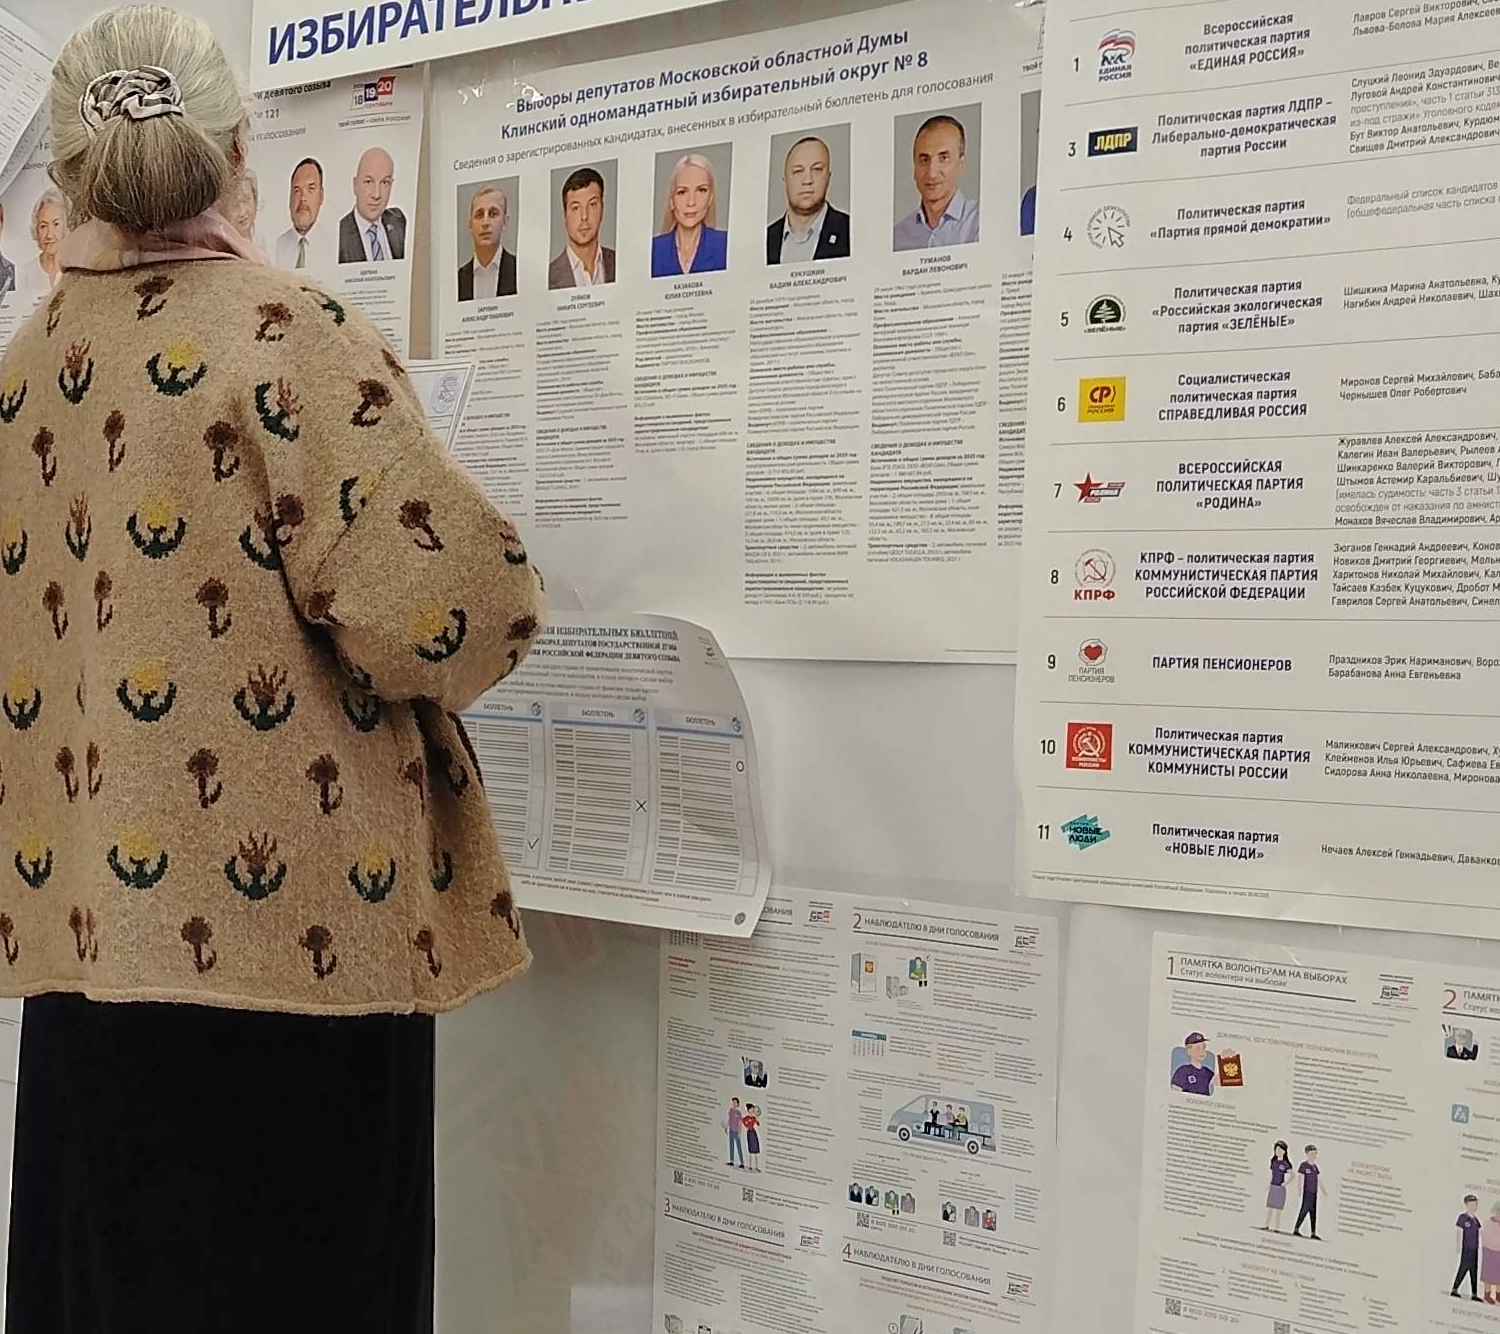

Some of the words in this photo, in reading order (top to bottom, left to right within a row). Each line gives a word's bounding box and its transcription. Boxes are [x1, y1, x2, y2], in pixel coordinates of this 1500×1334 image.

[1203, 14, 1293, 36] Всероссийская
[1185, 35, 1267, 55] политическая
[1269, 29, 1310, 45] партия
[1073, 57, 1080, 72] 1
[1189, 53, 1246, 72] «ЕДИНАЯ
[1249, 46, 1305, 64] РОССИЯ»
[516, 91, 573, 114] Выборы
[575, 77, 655, 105] депутатов
[659, 55, 760, 87] Московской
[764, 37, 853, 69] областной
[856, 30, 908, 56] Думы
[1098, 64, 1132, 75] ЕДИНАЯ
[1098, 72, 1132, 82] РОССИЯ
[501, 113, 566, 140] Клинский
[569, 91, 698, 129] одномандатный
[701, 67, 835, 105] избирательный
[839, 61, 890, 81] округ
[894, 54, 913, 72] №
[917, 51, 928, 68] 8
[265, 109, 279, 119] 121
[1157, 109, 1242, 127] Политическая
[1245, 104, 1285, 119] партия
[1287, 97, 1323, 113] ЛДПР
[453, 155, 496, 171] Сведения
[497, 154, 504, 164] о
[505, 137, 602, 163] зарегистрированных
[603, 127, 665, 145] кандидатах,
[667, 117, 727, 135] внесенных
[728, 116, 736, 126] в
[737, 98, 823, 124] избирательный
[824, 91, 889, 109] бюллетень
[890, 86, 914, 101] для
[916, 72, 993, 95] голосования
[1151, 115, 1337, 145] Либерально-демократическая
[1068, 142, 1077, 157] 3
[1094, 133, 1132, 152] ЛДПР
[1200, 144, 1241, 159] партия
[1244, 138, 1287, 153] России
[1177, 204, 1262, 221] Политическая
[1264, 200, 1305, 215] партия
[1063, 227, 1072, 242] 4
[1150, 226, 1200, 241] «Партия
[1203, 220, 1248, 238] прямой
[1249, 215, 1331, 234] демократии»
[919, 255, 951, 265] ТУМАНОВ
[1174, 284, 1258, 299] Политическая
[1261, 281, 1302, 295] партия
[1152, 302, 1231, 317] «Российская
[1233, 297, 1323, 313] экологическая
[1060, 311, 1069, 327] 5
[1178, 322, 1219, 335] партия
[1222, 313, 1295, 331] «ЗЕЛЁНЫЕ»
[1178, 371, 1291, 387] Социалистическая
[1169, 391, 1253, 404] политическая
[1256, 389, 1297, 402] партия
[1339, 390, 1388, 402] Чернышев
[1389, 388, 1412, 398] Олег
[1413, 386, 1467, 397] Робертович
[1057, 397, 1066, 412] 6
[1158, 406, 1255, 421] СПРАВЕДЛИВАЯ
[1258, 403, 1307, 418] РОССИЯ
[1178, 458, 1282, 475] ВСЕРОССИЙСКАЯ
[1053, 483, 1062, 498] 7
[1156, 478, 1253, 493] ПОЛИТИЧЕСКАЯ
[1256, 477, 1304, 491] ПАРТИЯ
[1196, 496, 1262, 511] «РОДИНА»
[1140, 551, 1175, 565] КПРФ
[1187, 554, 1270, 564] политическая
[1273, 553, 1315, 566] партия
[1050, 569, 1059, 584] 8
[1135, 569, 1267, 581] КОММУНИСТИЧЕСКАЯ
[1270, 569, 1318, 581] ПАРТИЯ
[1074, 589, 1116, 600] КПРФ
[1145, 583, 1227, 599] РОССИЙСКОЙ
[1229, 586, 1305, 601] ФЕДЕРАЦИИ
[1047, 654, 1056, 669] 9
[1152, 656, 1199, 669] ПАРТИЯ
[1202, 657, 1292, 671] ПЕНСИОНЕРОВ
[1078, 667, 1105, 675] ПАРТИЯ
[1328, 667, 1382, 679] Барабанова
[1383, 669, 1407, 679] Анна
[1408, 669, 1461, 680] Евгеньевна
[1068, 675, 1115, 684] ПЕНСИОНЕРОВ
[1155, 727, 1239, 742] Политическая
[1242, 733, 1283, 746] партия
[1040, 739, 1056, 755] 10
[1128, 743, 1259, 761] КОММУНИСТИЧЕСКАЯ
[1262, 749, 1311, 763] ПАРТИЯ
[1148, 761, 1235, 777] КОММУНИСТЫ
[1238, 765, 1288, 780] РОССИИ
[1037, 824, 1050, 840] 11
[1152, 823, 1235, 841] Политическая
[1237, 831, 1279, 844] партия
[1165, 841, 1215, 857] «НОВЫЕ
[1217, 845, 1264, 861] ЛЮДИ»
[853, 913, 862, 929] 2
[864, 918, 922, 932] НАБЛЮДАТЕЛЮ
[928, 925, 945, 934] ДНИ
[945, 927, 1000, 942] ГОЛОСОВАНИЯ
[1167, 956, 1175, 976] 1
[1180, 957, 1224, 970] ПАМЯТКА
[1288, 970, 1302, 979] НА
[1303, 971, 1348, 985] ВЫБОРАХ
[842, 1243, 852, 1259] 4
[853, 1248, 911, 1268] НАБЛЮДАТЕЛЮ
[917, 1262, 935, 1273] ДНИ
[935, 1266, 991, 1286] ГОЛОСОВАНИЯ
